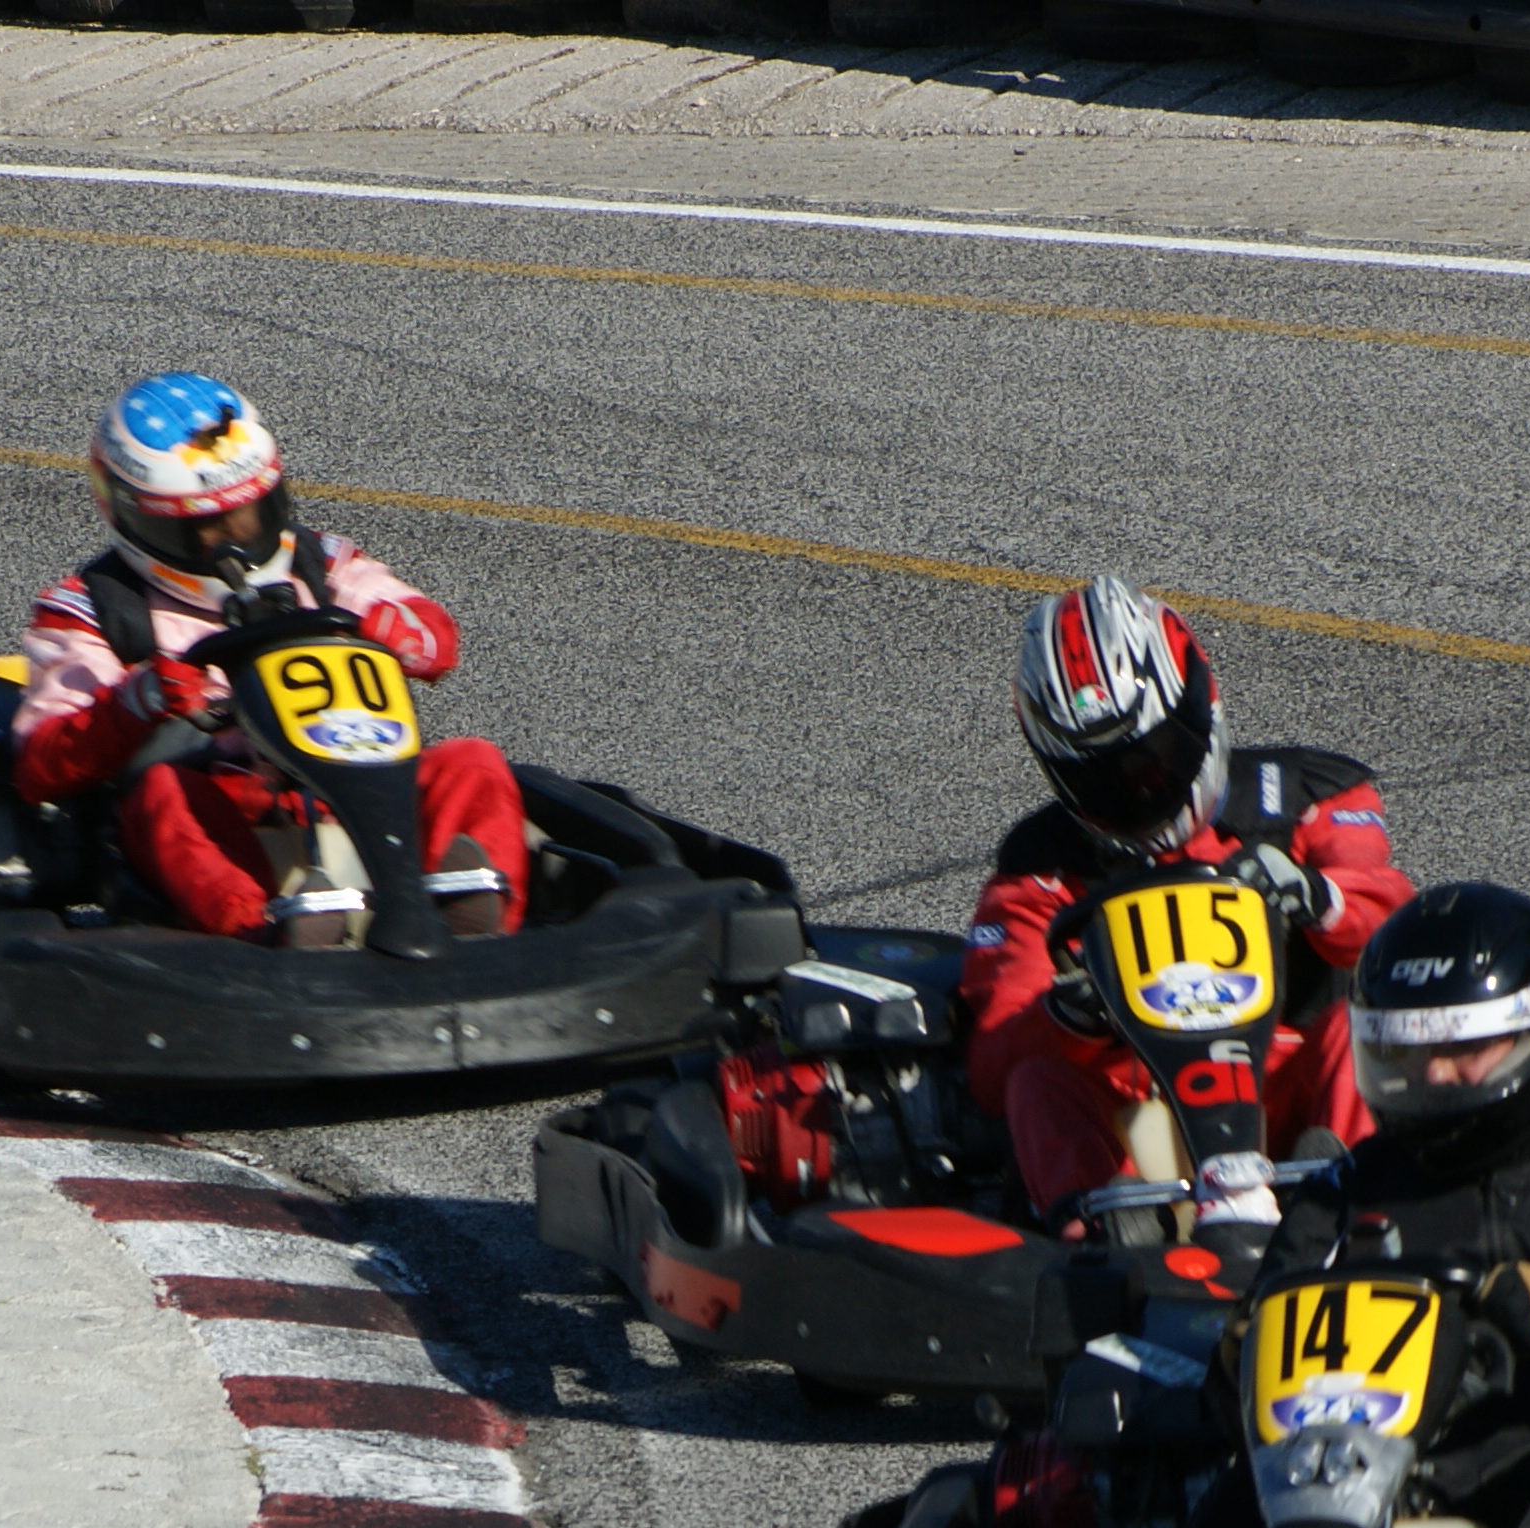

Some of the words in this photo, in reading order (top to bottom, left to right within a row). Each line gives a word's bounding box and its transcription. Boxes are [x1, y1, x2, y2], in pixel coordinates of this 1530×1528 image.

[282, 655, 387, 717] 90
[1127, 892, 1247, 976] 115
[1391, 957, 1455, 987] agv
[1280, 1290, 1431, 1382] 147
